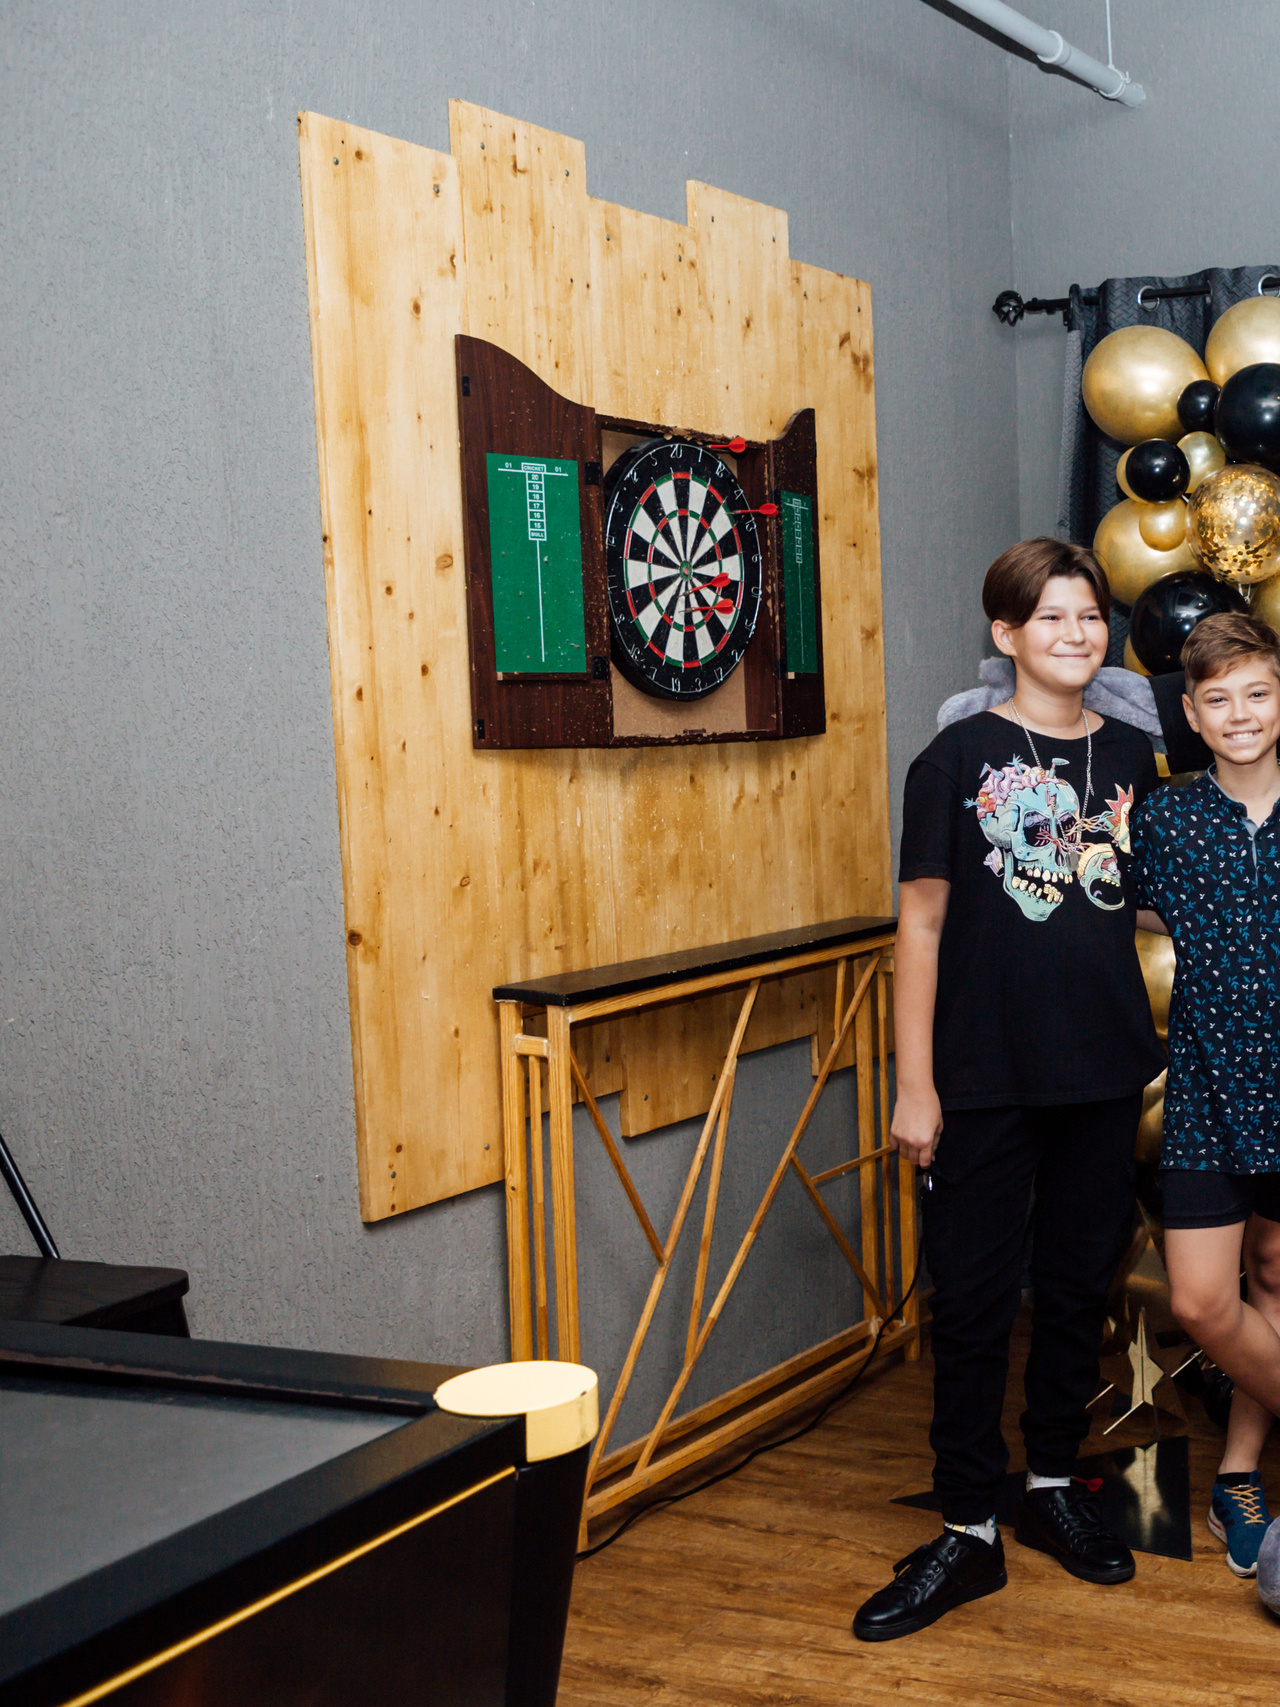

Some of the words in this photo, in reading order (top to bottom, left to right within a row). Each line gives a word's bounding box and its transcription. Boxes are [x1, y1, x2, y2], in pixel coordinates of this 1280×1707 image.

[670, 443, 683, 459] 20
[698, 448, 703, 463] 1
[671, 677, 681, 693] 19
[695, 677, 702, 692] 3
